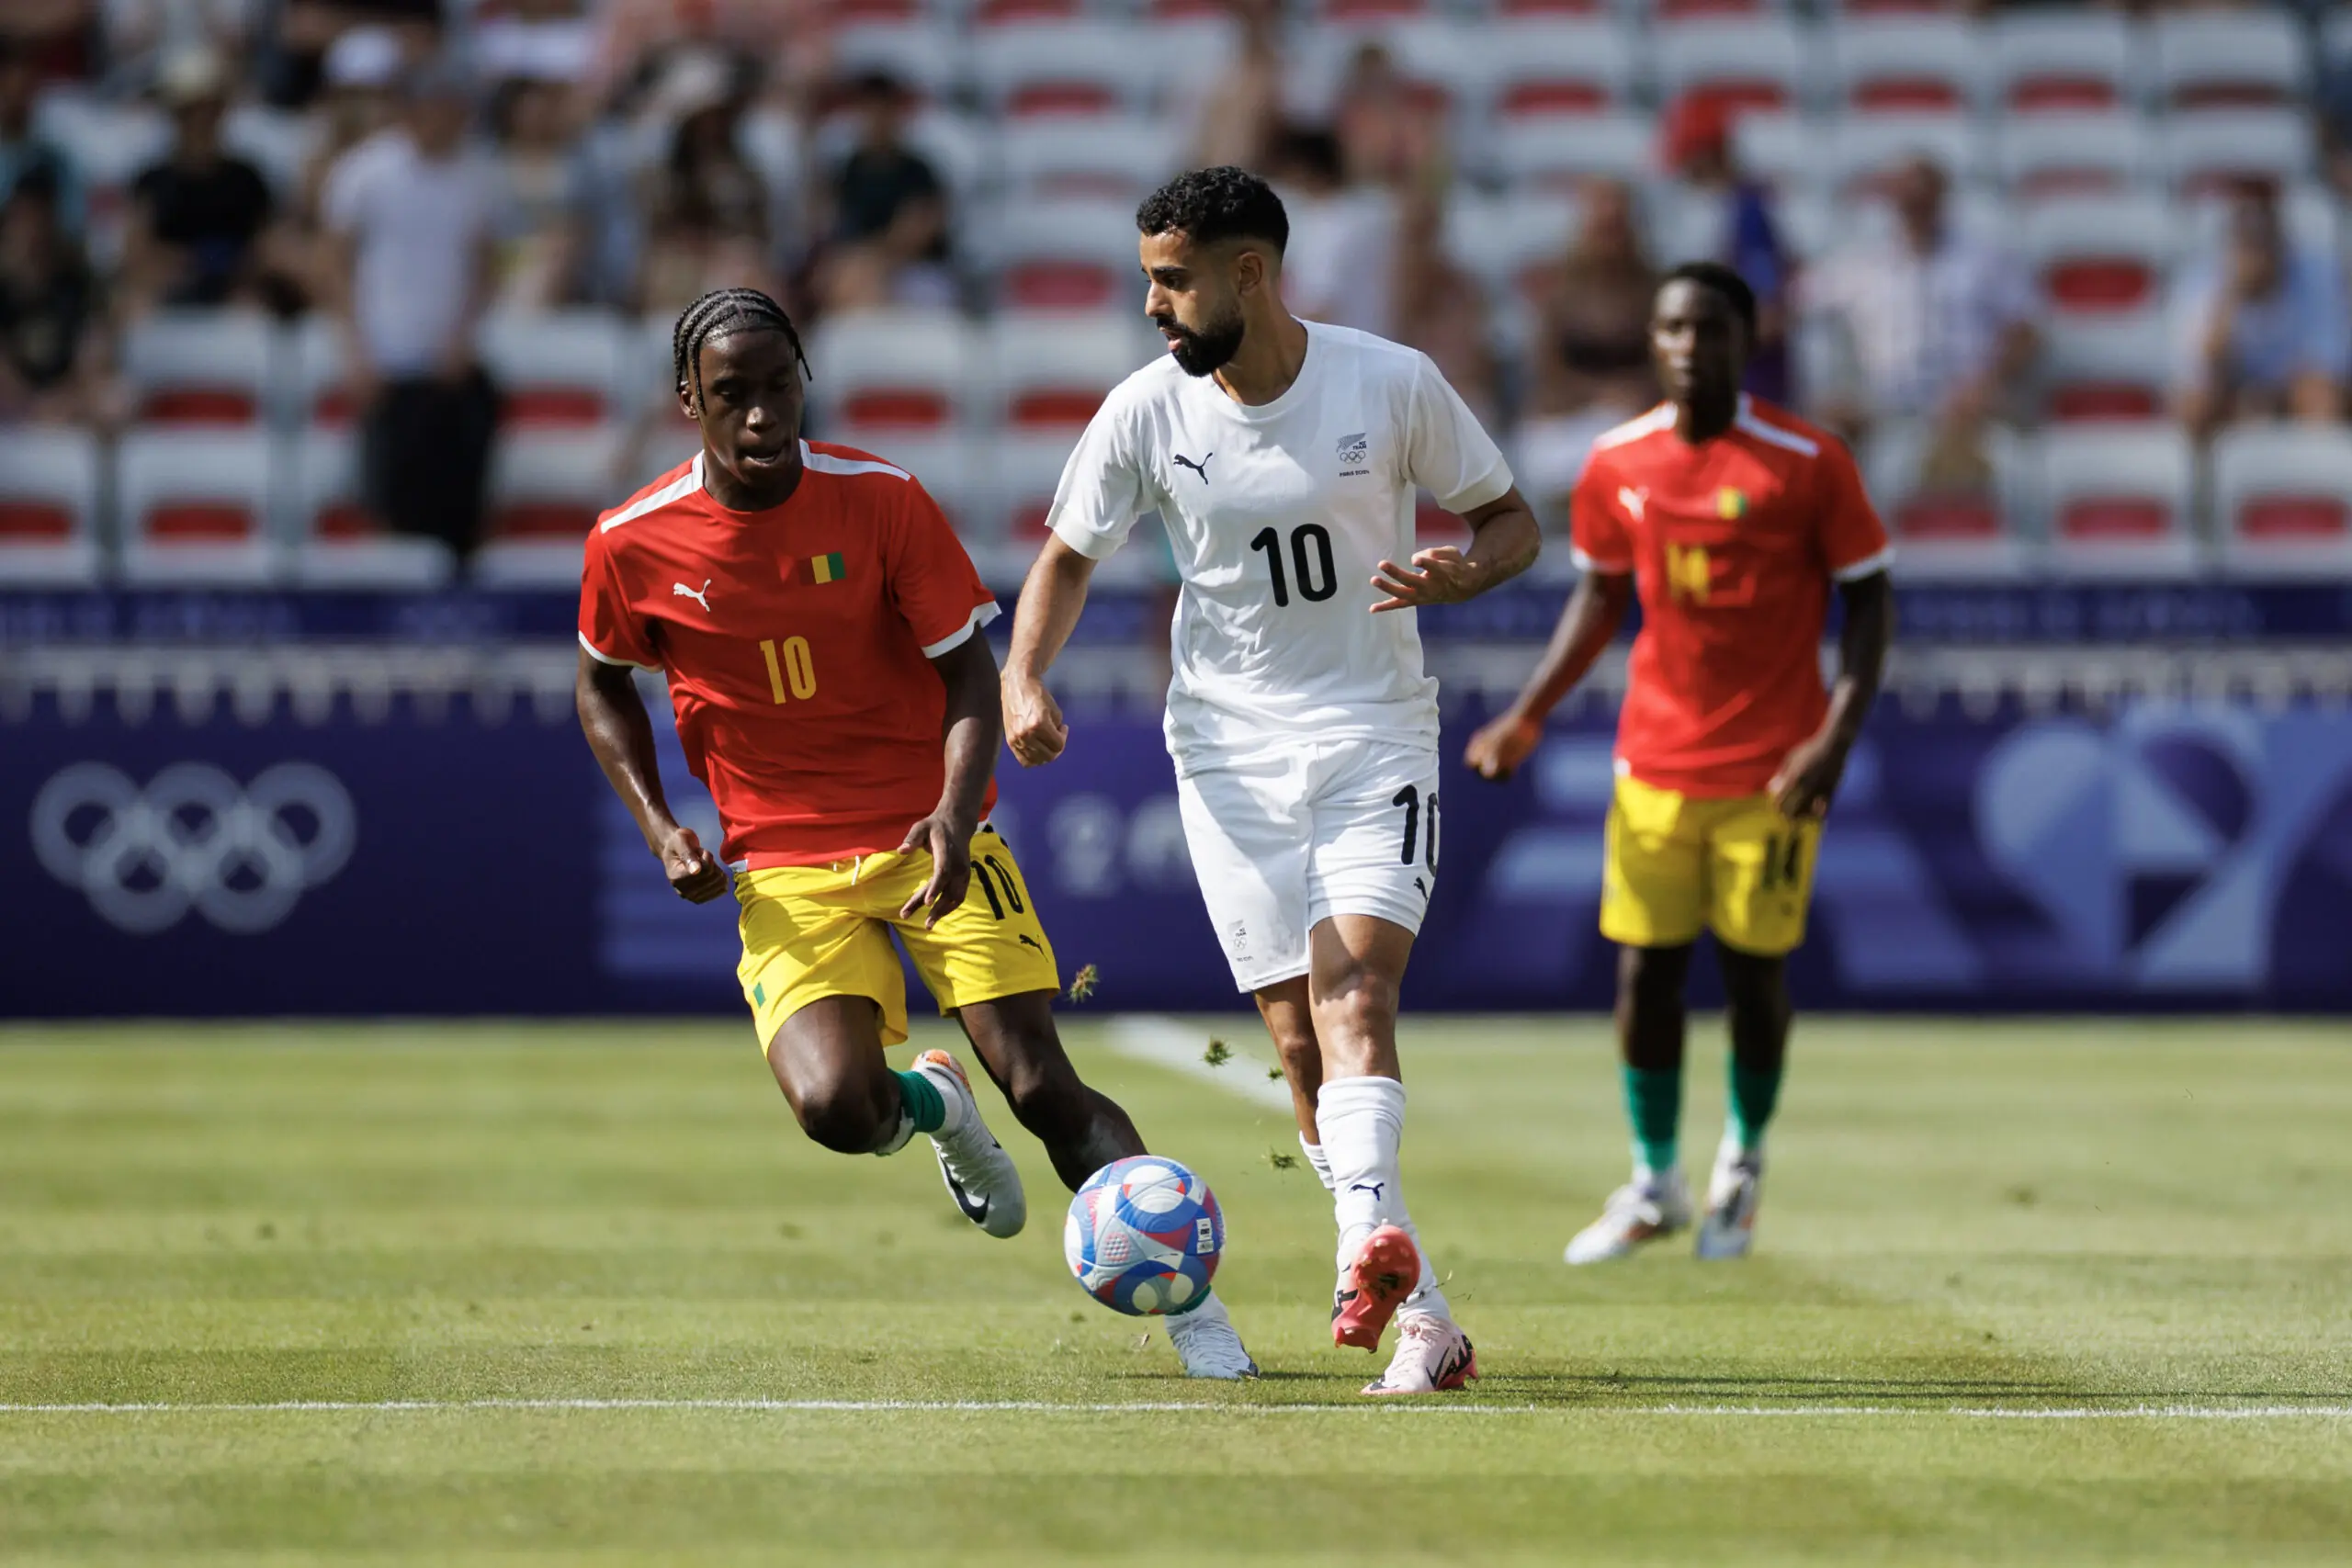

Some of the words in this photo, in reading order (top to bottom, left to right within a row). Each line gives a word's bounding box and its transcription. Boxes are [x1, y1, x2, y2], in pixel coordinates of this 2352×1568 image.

[1250, 523, 1338, 607] 10
[759, 636, 817, 705] 10
[971, 854, 1024, 921] 10
